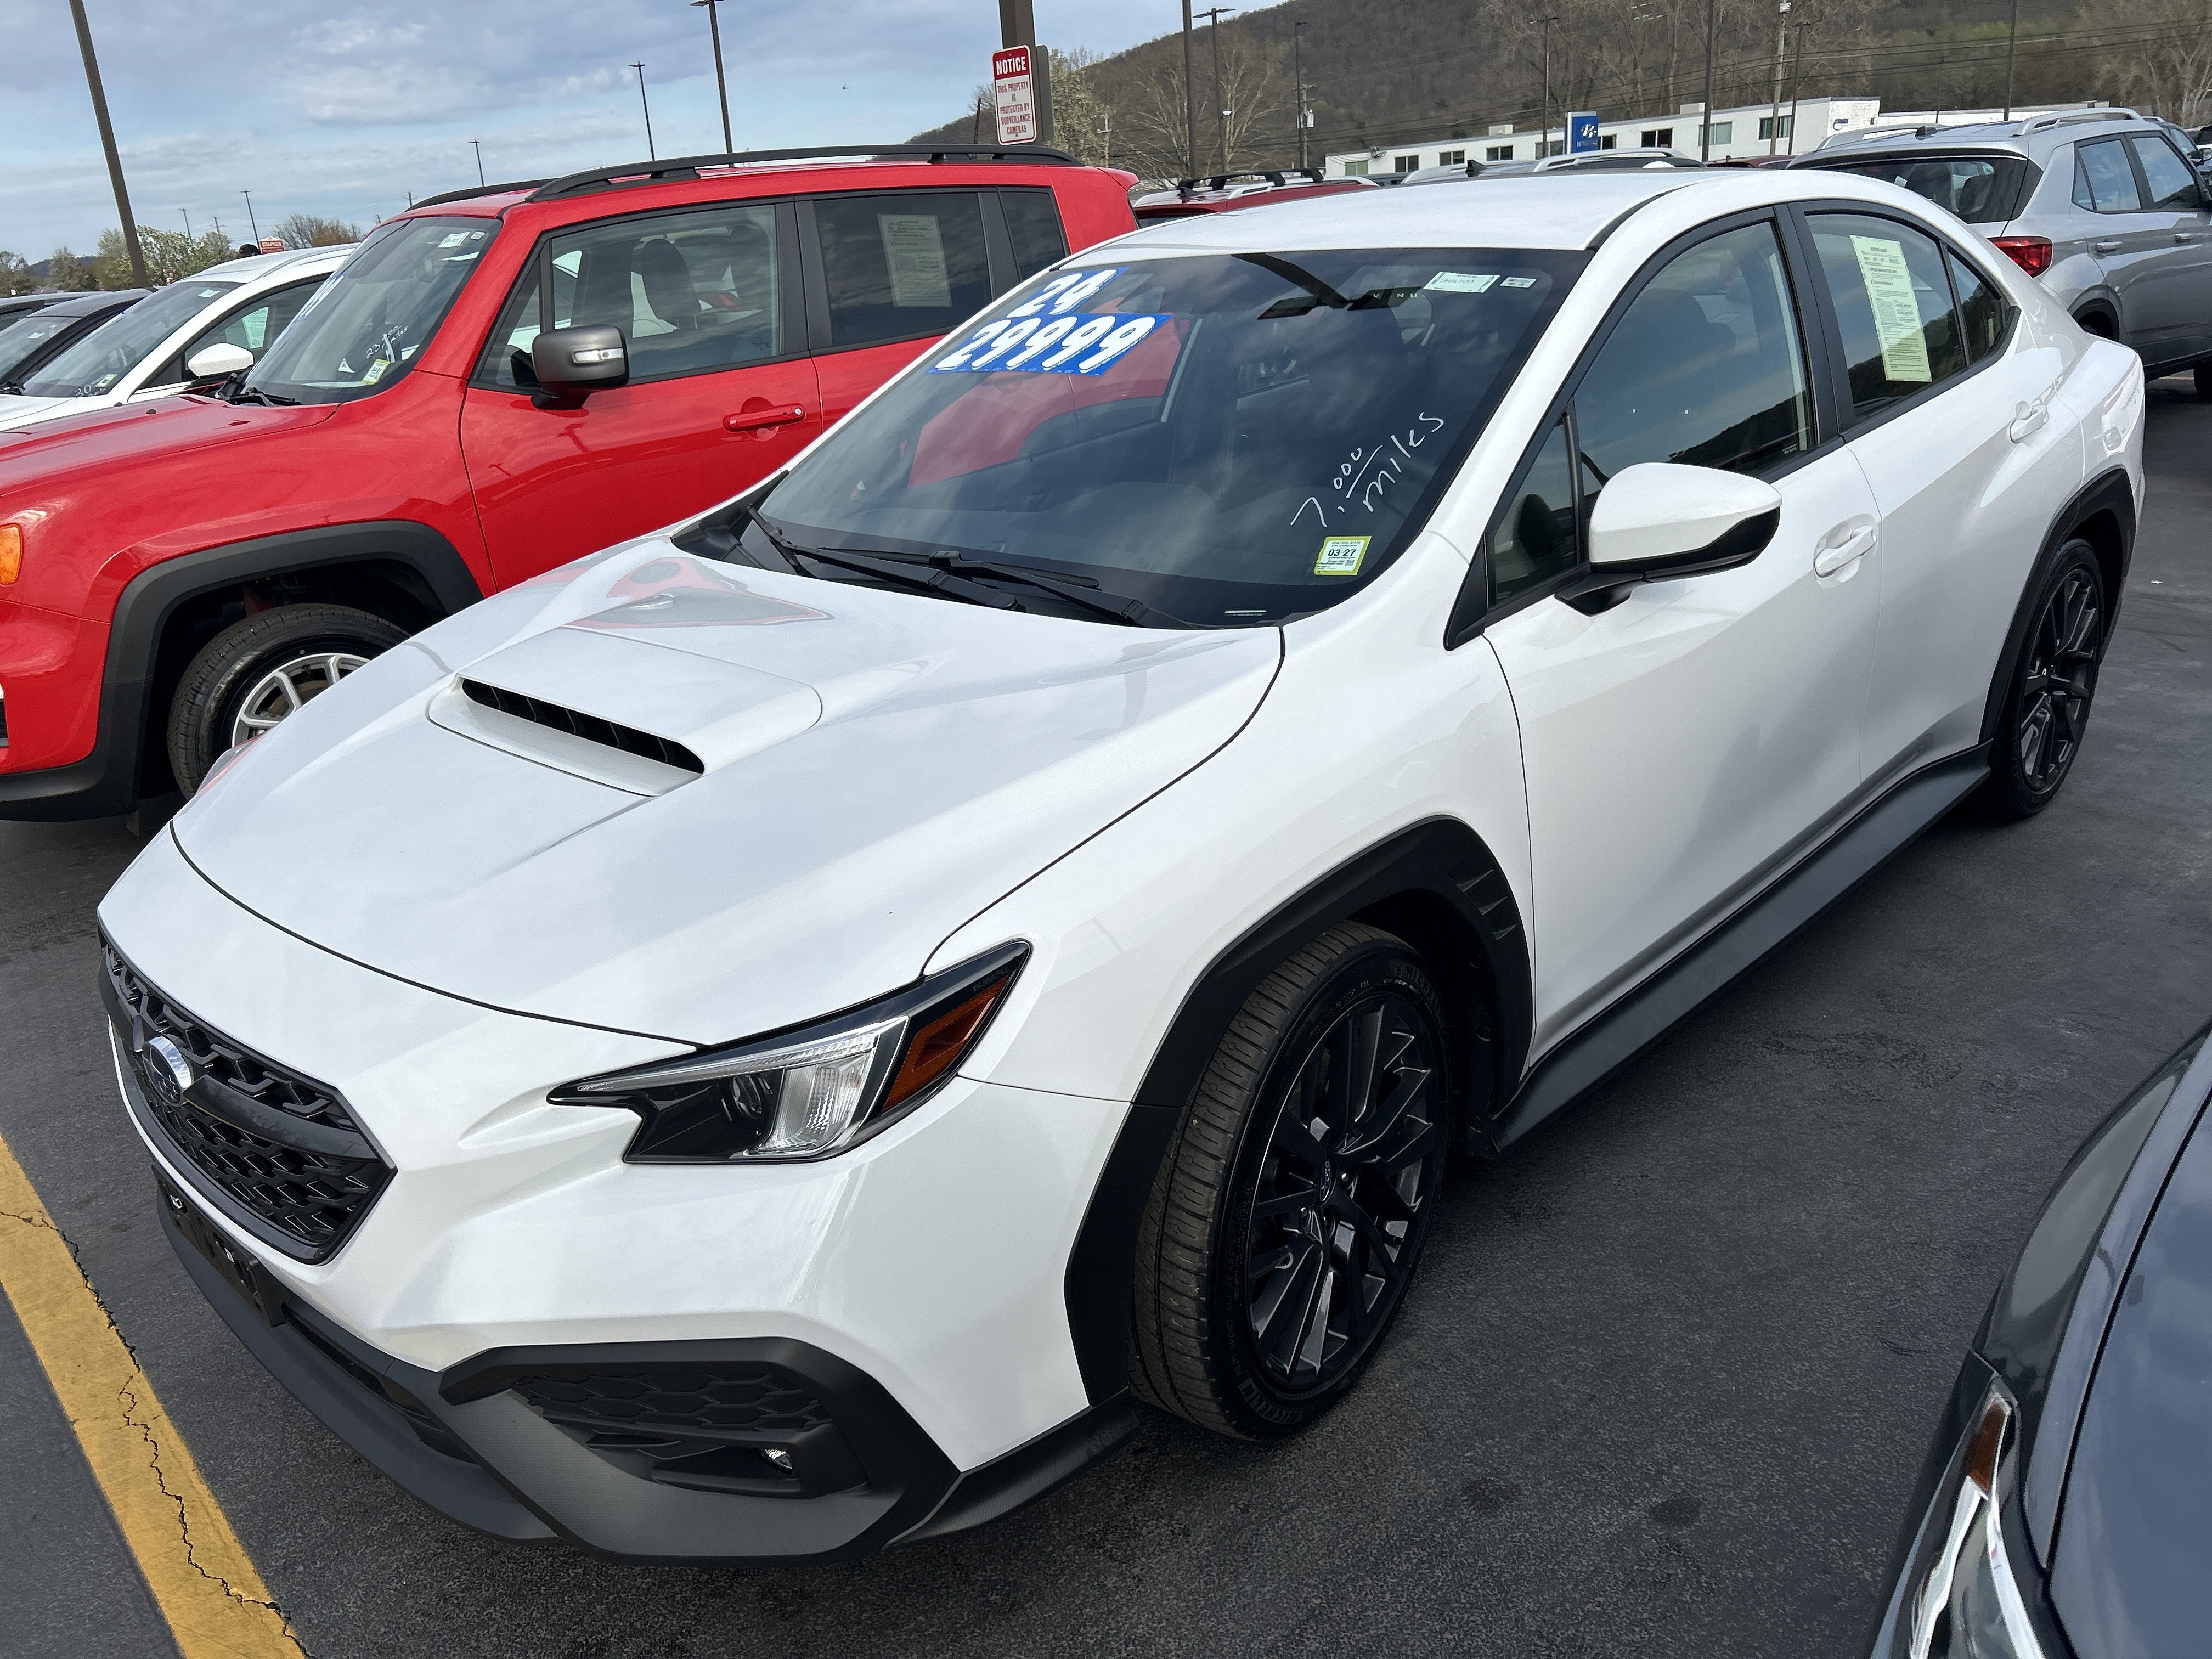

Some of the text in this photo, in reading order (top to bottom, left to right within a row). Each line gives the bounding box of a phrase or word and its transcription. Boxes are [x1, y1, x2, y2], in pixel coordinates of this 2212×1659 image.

[996, 55, 1026, 75] NOTICE
[997, 81, 1028, 93] THIS PROPERTY
[1011, 93, 1017, 103] IS
[1000, 103, 1030, 115] PROTECTED BY
[1001, 113, 1031, 126] SURVEILLANCE
[1007, 125, 1027, 135] CAMERAS
[1007, 269, 1118, 318] 24
[935, 316, 1156, 374] 29999
[1363, 411, 1444, 512] miles
[1226, 1239, 1237, 1288] SEASON
[1226, 1317, 1237, 1350] SPORT
[1231, 1353, 1243, 1376] PILOT
[1242, 1384, 1299, 1424] MICHELIN
